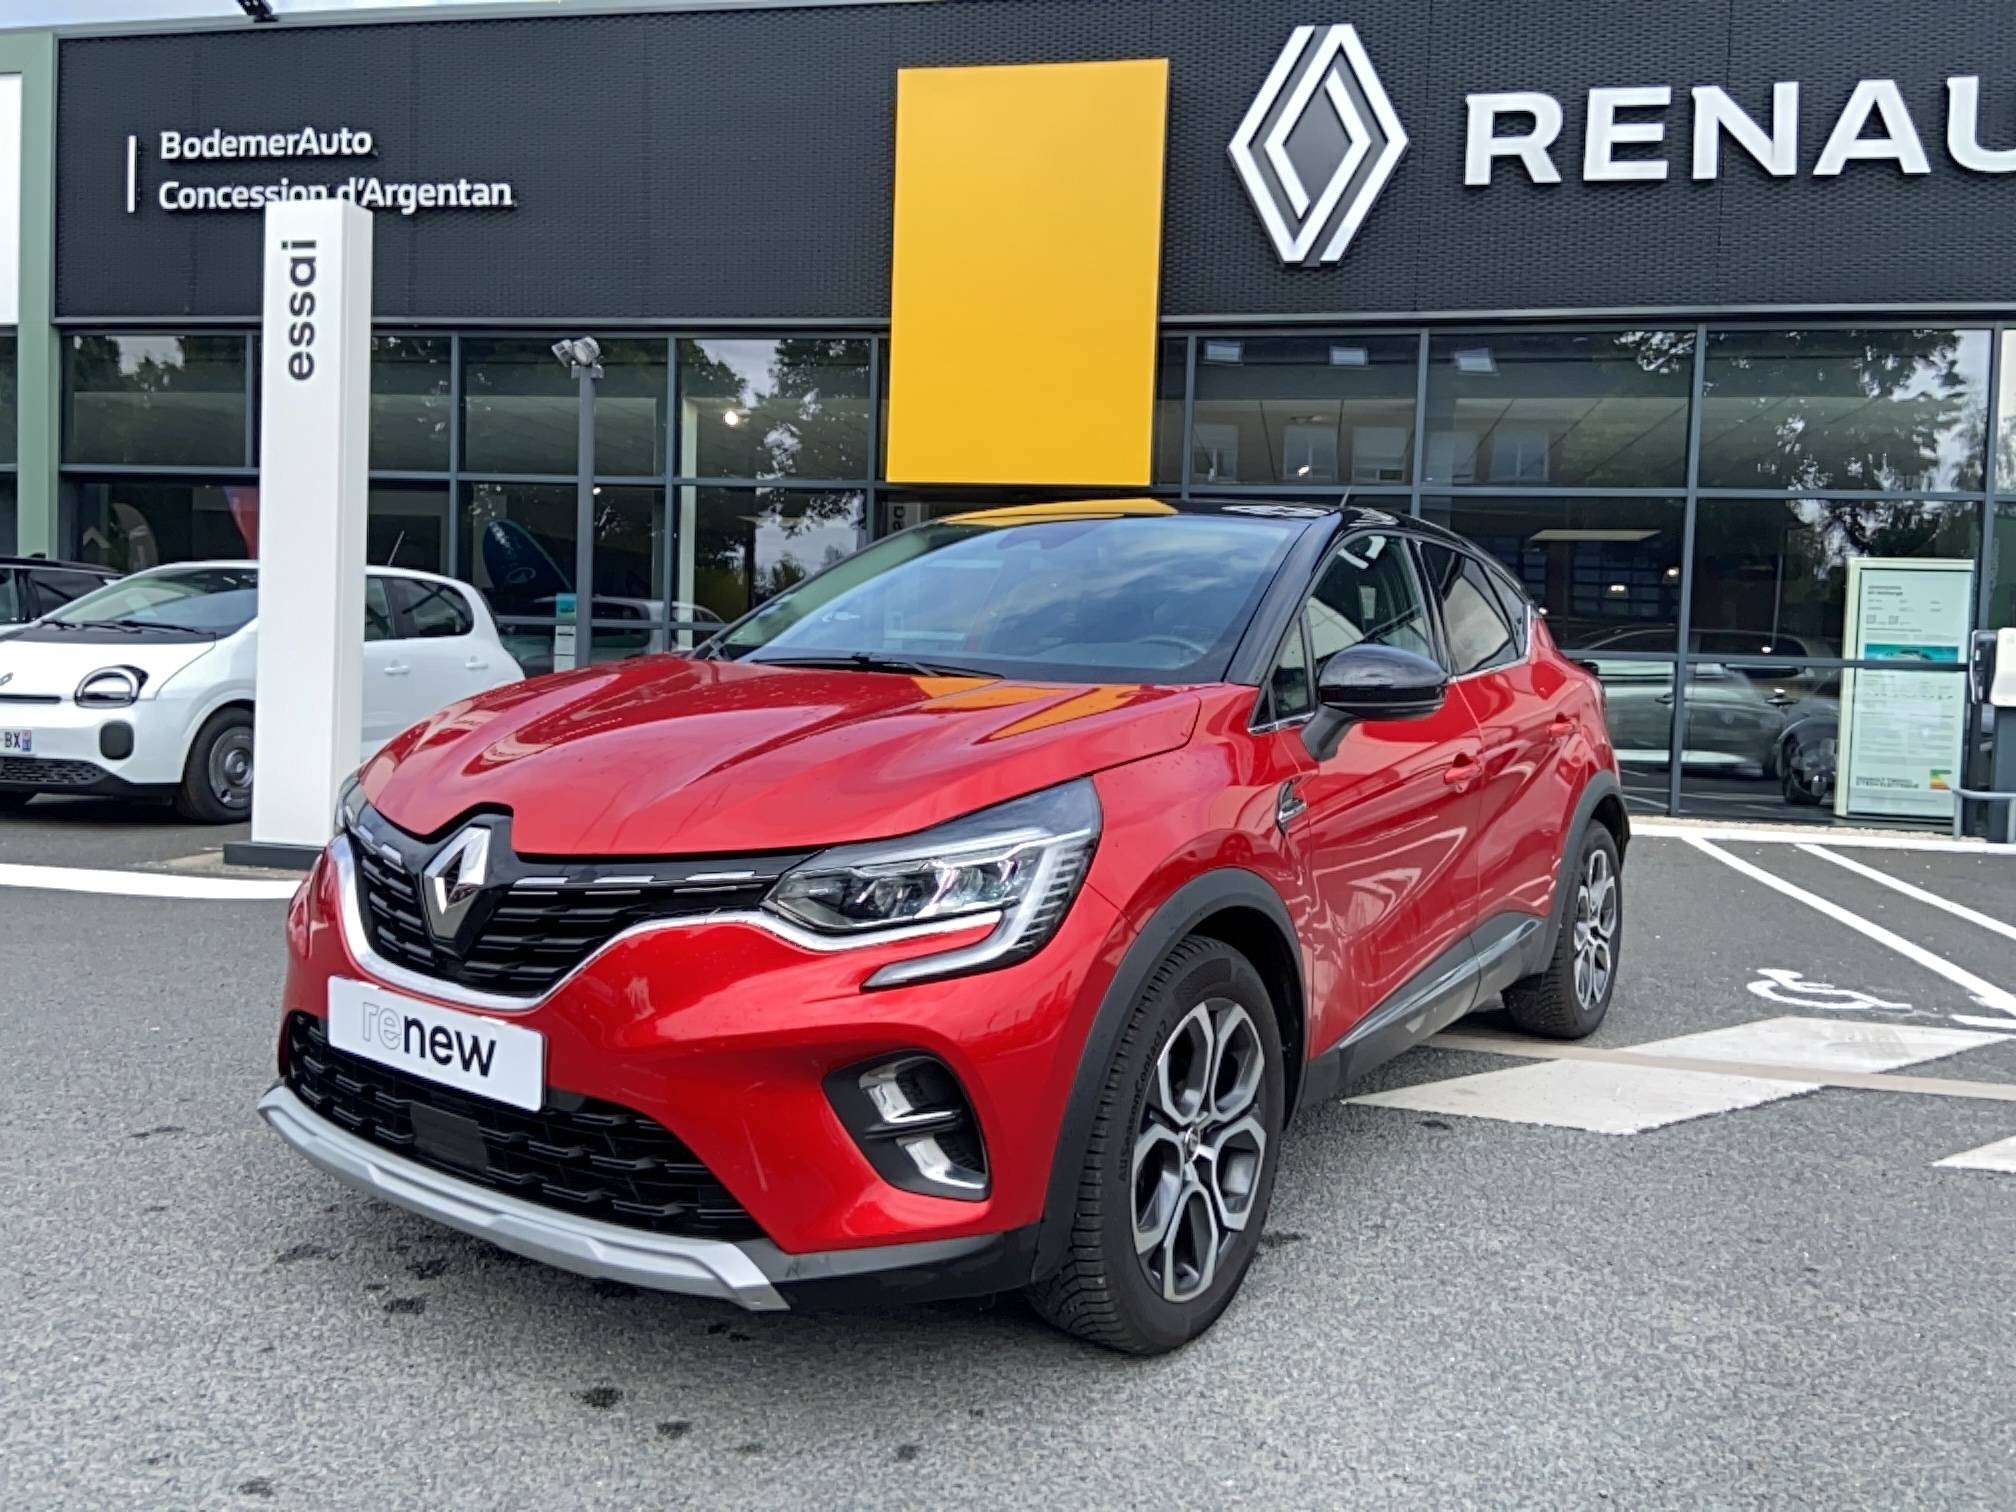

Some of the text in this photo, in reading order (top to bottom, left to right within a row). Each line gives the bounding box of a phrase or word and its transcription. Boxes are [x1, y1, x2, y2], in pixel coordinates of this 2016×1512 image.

[160, 127, 373, 160] BodemerAuto
[159, 177, 513, 215] Concession d'Argentan
[281, 240, 317, 381] essai
[362, 1001, 497, 1078] renew
